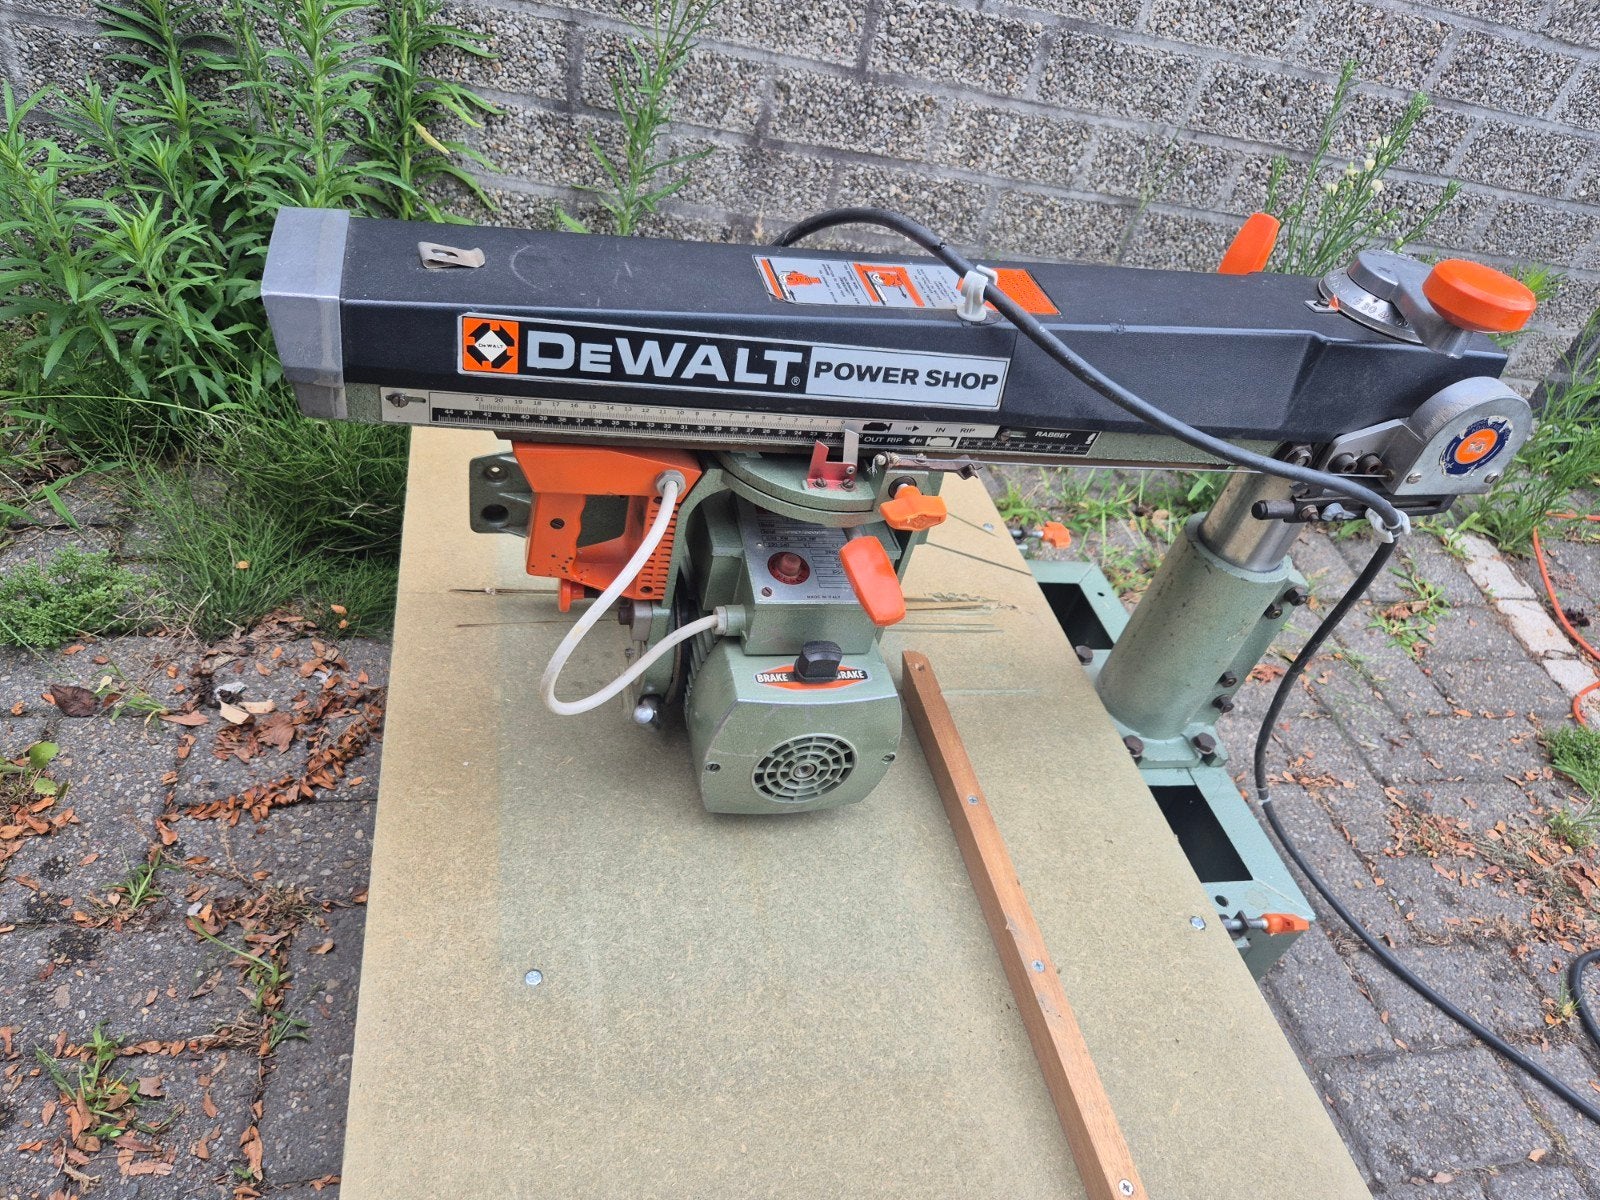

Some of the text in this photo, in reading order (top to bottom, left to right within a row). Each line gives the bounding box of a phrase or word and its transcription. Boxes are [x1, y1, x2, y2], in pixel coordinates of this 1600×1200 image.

[814, 361, 919, 385] POWER
[924, 369, 999, 390] SHOP
[1034, 430, 1071, 438] RABBET
[757, 672, 789, 682] BRAKE
